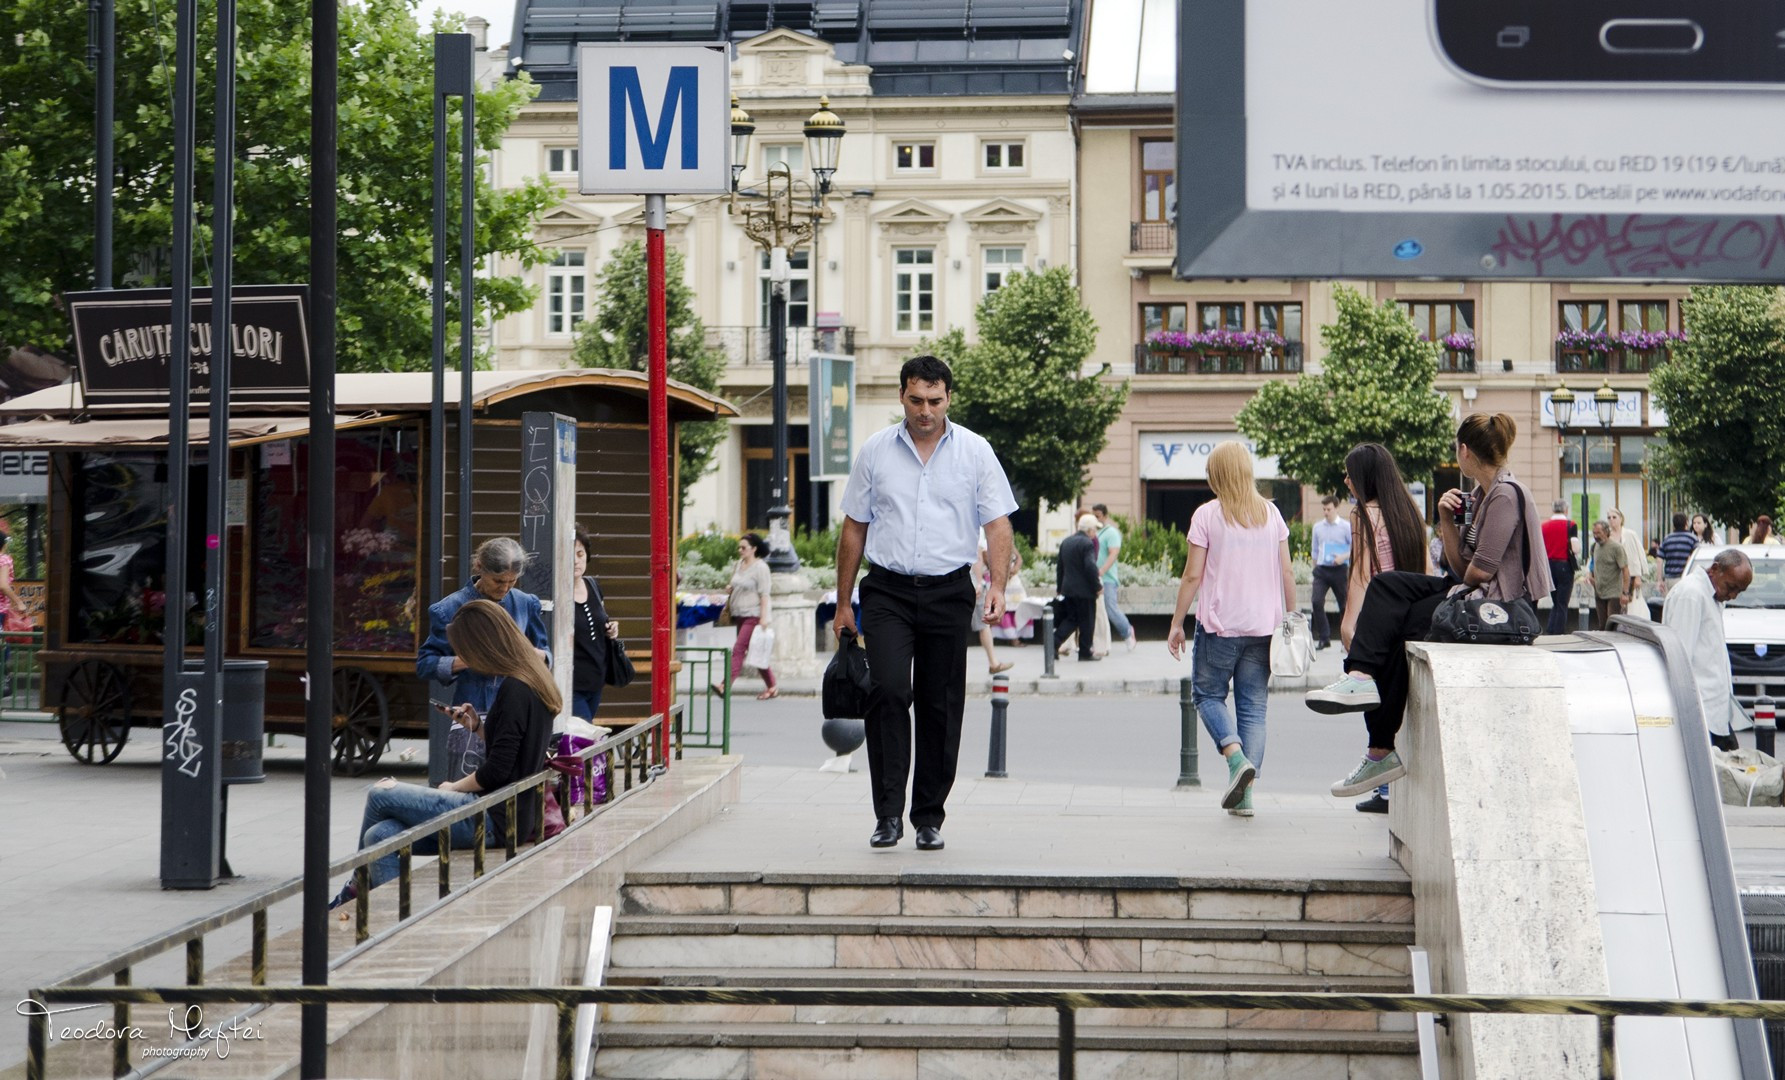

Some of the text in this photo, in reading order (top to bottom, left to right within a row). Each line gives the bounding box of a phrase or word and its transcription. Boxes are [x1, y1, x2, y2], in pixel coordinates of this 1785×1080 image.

[609, 66, 698, 170] M
[1272, 154, 1308, 172] TVA
[1311, 153, 1367, 172] inclus.
[1372, 153, 1438, 173] Telefon
[1441, 153, 1458, 172] în
[1462, 153, 1512, 172] limita
[1515, 154, 1589, 174] stocului,
[1594, 158, 1616, 173] cu
[1620, 155, 1657, 173] RED
[1662, 155, 1683, 173] 19
[1272, 183, 1286, 202] și
[1289, 184, 1301, 199] 4
[1305, 183, 1340, 200] luni
[1343, 183, 1359, 200] la
[1364, 183, 1405, 202] RED,
[1408, 184, 1452, 203] până
[1456, 183, 1472, 200] la
[1478, 183, 1571, 200] 1.05.2015.
[1575, 183, 1633, 201] Detalii
[1636, 186, 1659, 205] pe
